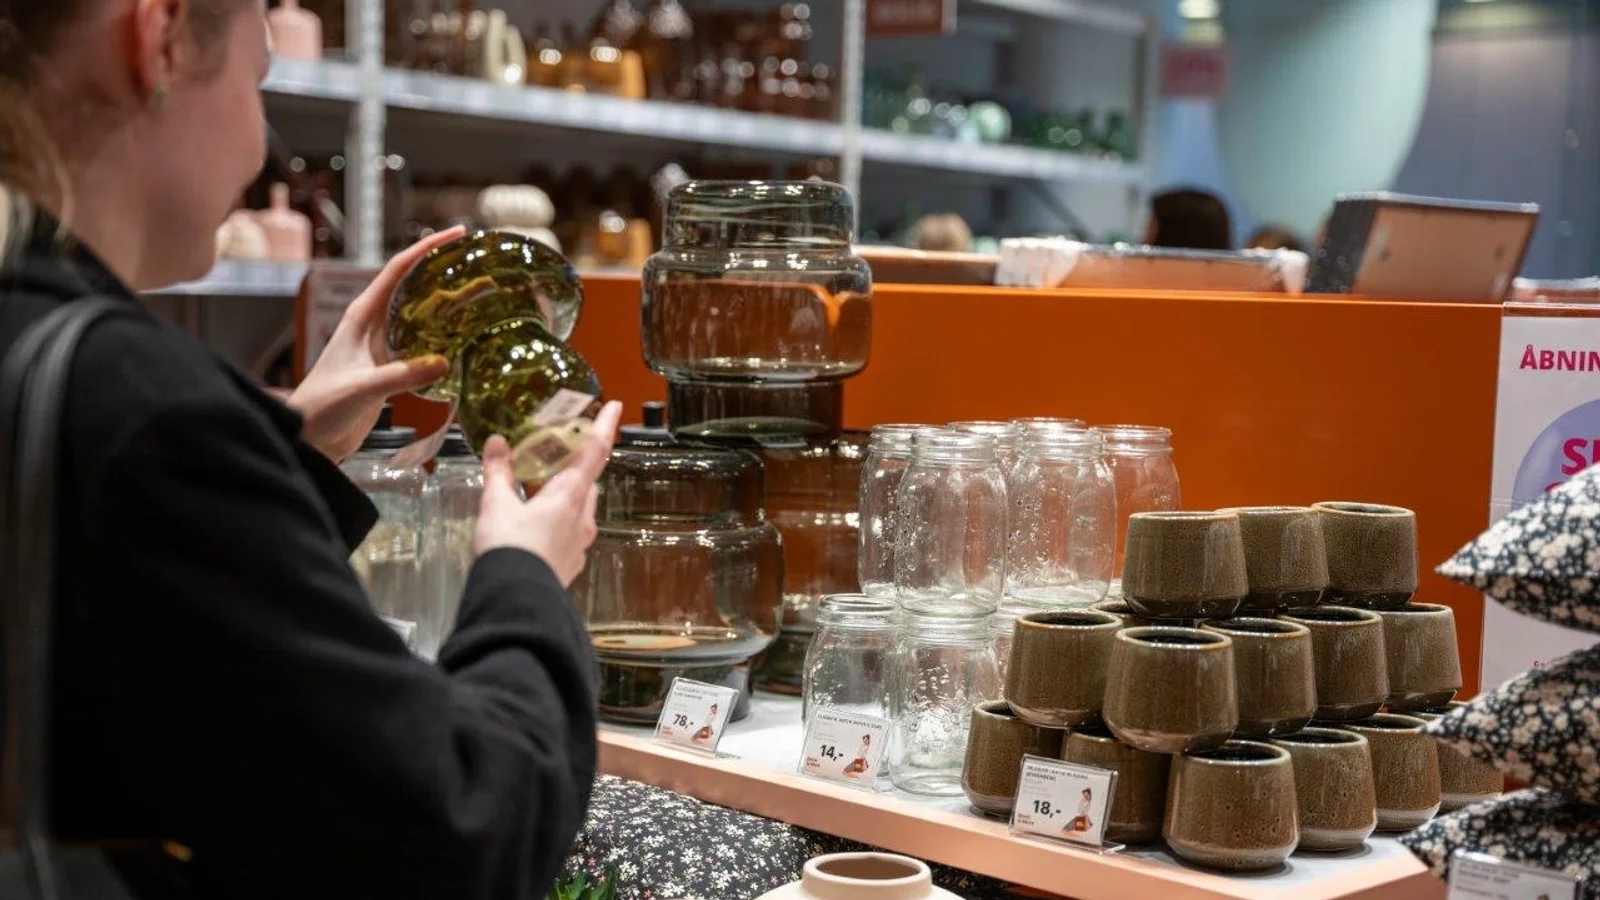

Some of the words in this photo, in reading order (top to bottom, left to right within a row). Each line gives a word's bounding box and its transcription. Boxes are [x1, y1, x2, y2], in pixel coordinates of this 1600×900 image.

[1561, 437, 1600, 476] S
[673, 713, 694, 729] 78,-
[820, 744, 844, 761] 14,-
[1033, 799, 1061, 818] 18,-
